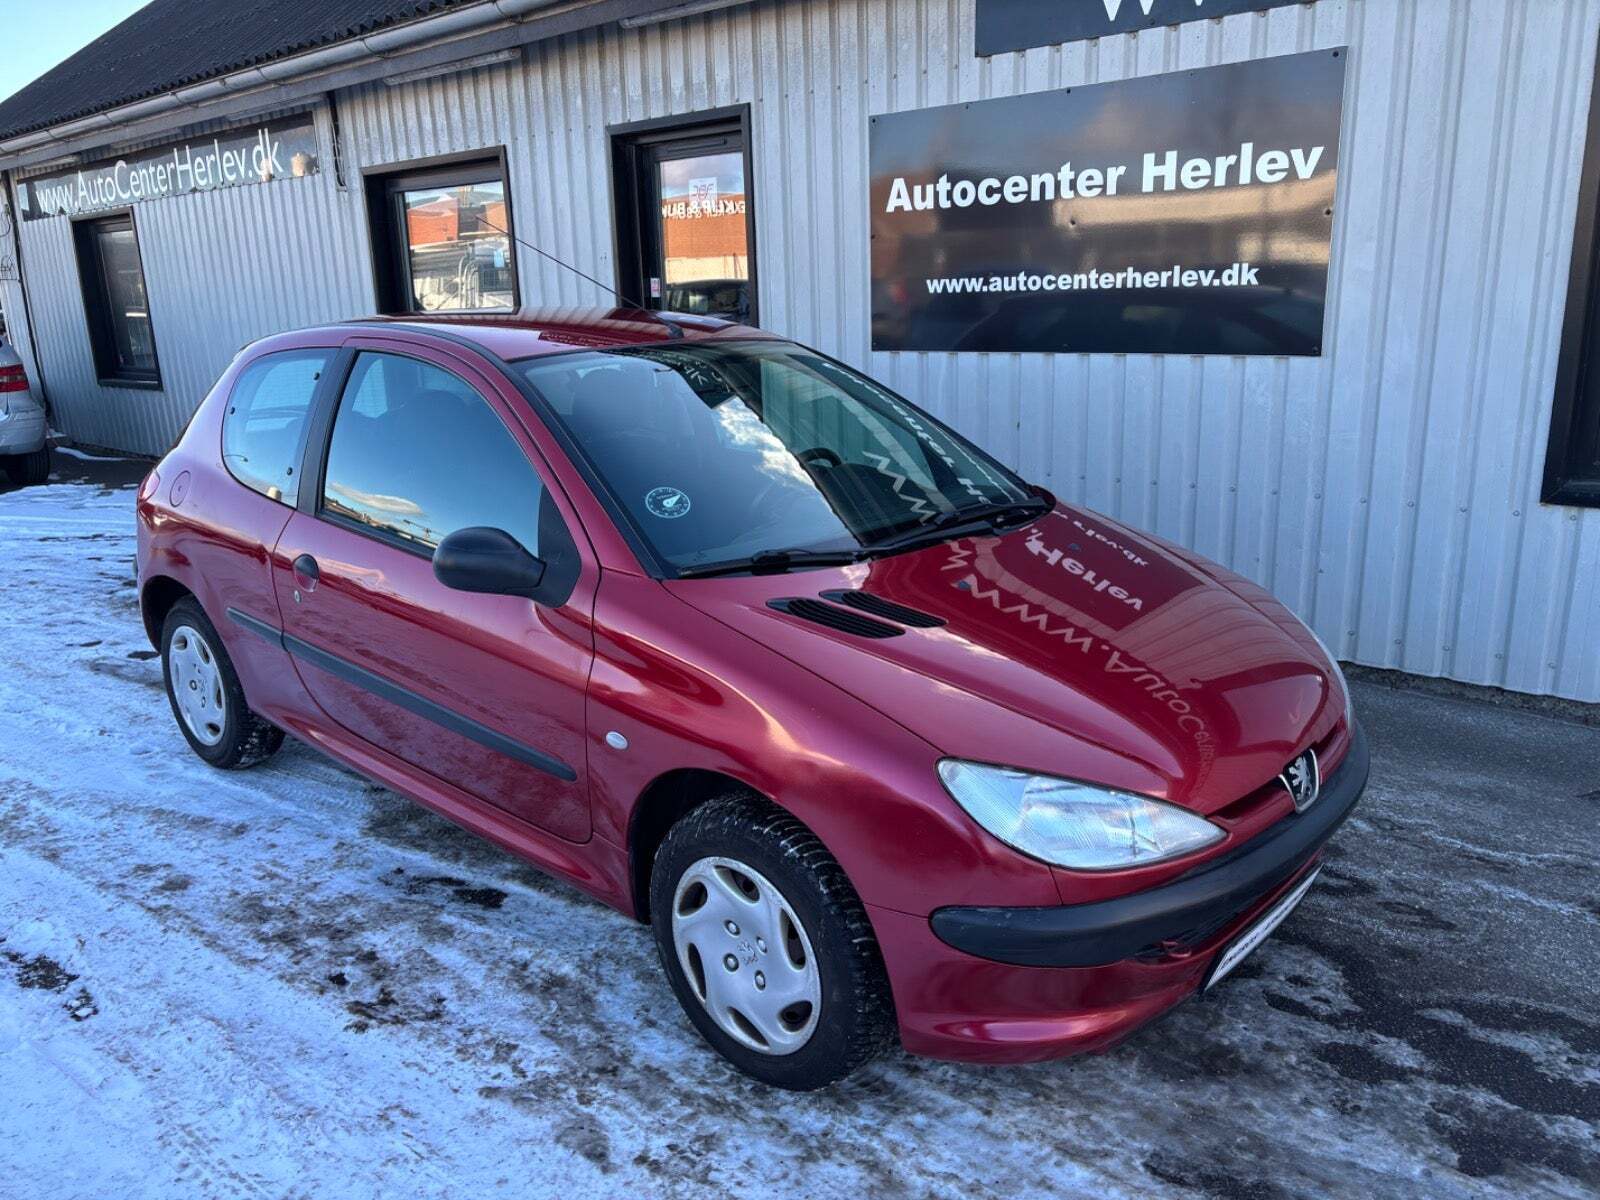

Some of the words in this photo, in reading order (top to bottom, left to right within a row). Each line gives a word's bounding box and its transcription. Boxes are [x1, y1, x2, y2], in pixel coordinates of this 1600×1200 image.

[36, 128, 283, 212] www.AutoCenterHerlev.dk
[886, 161, 1126, 213] Autocenter
[1141, 142, 1324, 193] Herlev
[926, 262, 1259, 294] www.autocenterherlev.dk
